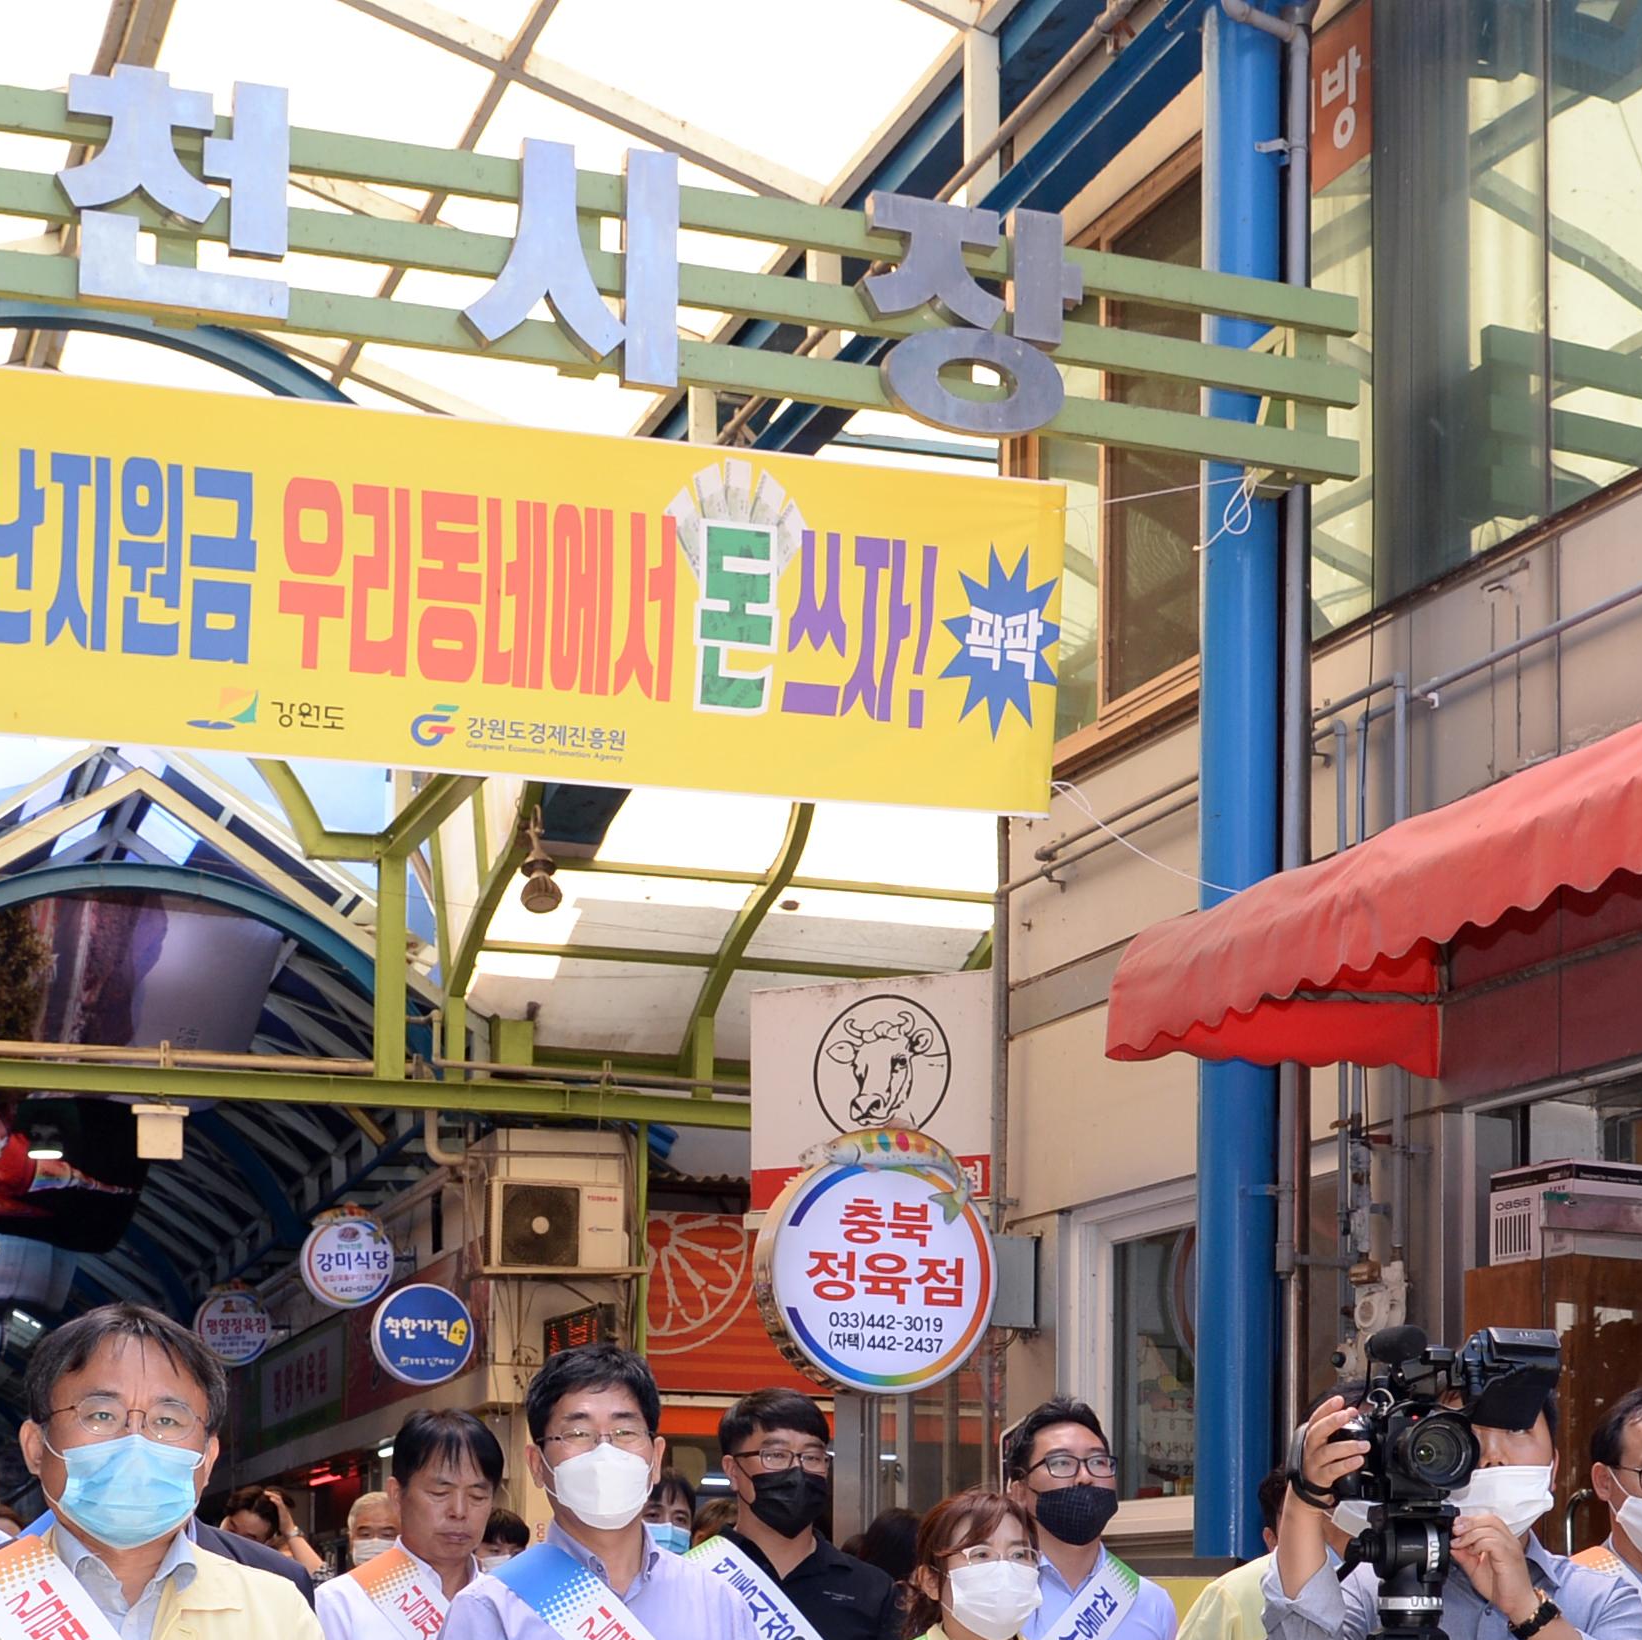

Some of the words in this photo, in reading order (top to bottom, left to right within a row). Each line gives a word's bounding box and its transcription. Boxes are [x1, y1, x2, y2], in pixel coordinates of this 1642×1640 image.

[278, 476, 677, 702] 우리동네에서
[963, 604, 1044, 681] 팍팍
[270, 700, 345, 731] 강원도
[466, 717, 627, 751] 강원도경제진흥원
[838, 1198, 934, 1248] 충북
[316, 1250, 390, 1273] 강미식당
[805, 1250, 966, 1308] 정육점
[384, 1316, 448, 1340] 착한가격
[829, 1311, 943, 1332] 033)442-3019
